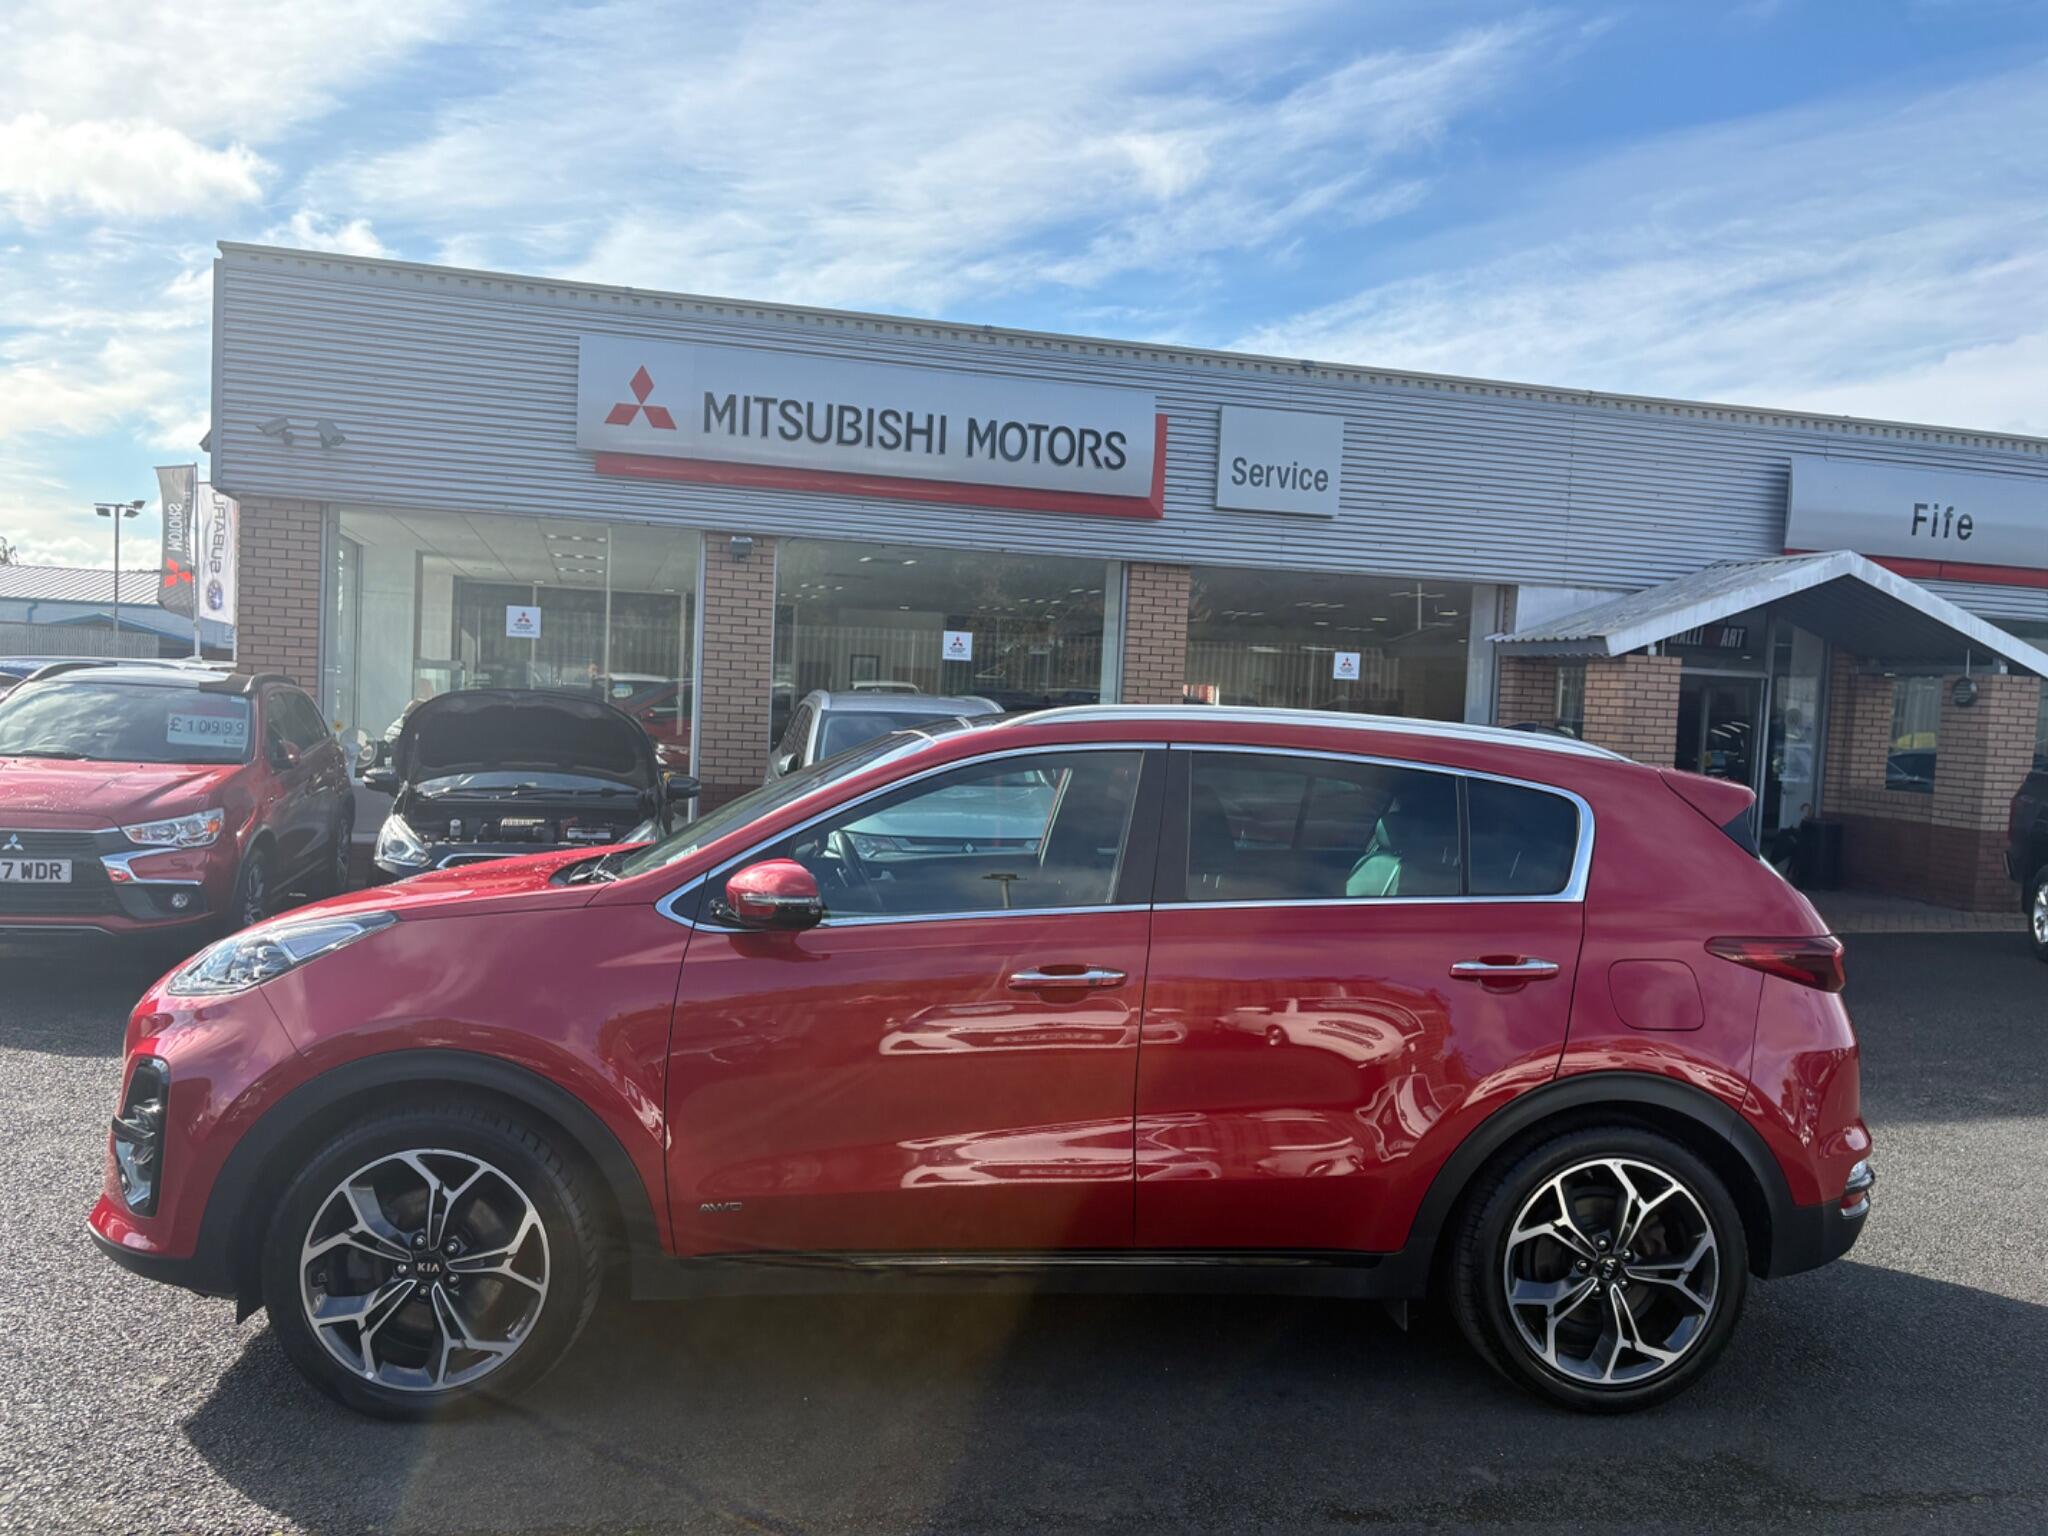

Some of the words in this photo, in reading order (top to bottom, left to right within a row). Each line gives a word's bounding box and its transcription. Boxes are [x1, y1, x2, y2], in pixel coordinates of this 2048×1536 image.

[703, 390, 947, 455] MITSUBISHI
[966, 416, 1127, 471] MOTORS
[1231, 456, 1329, 492] Service
[1911, 503, 1973, 541] Fife
[1720, 627, 1746, 648] ART
[1, 862, 14, 880] 7
[21, 862, 62, 880] WDR
[417, 1262, 440, 1273] KIA
